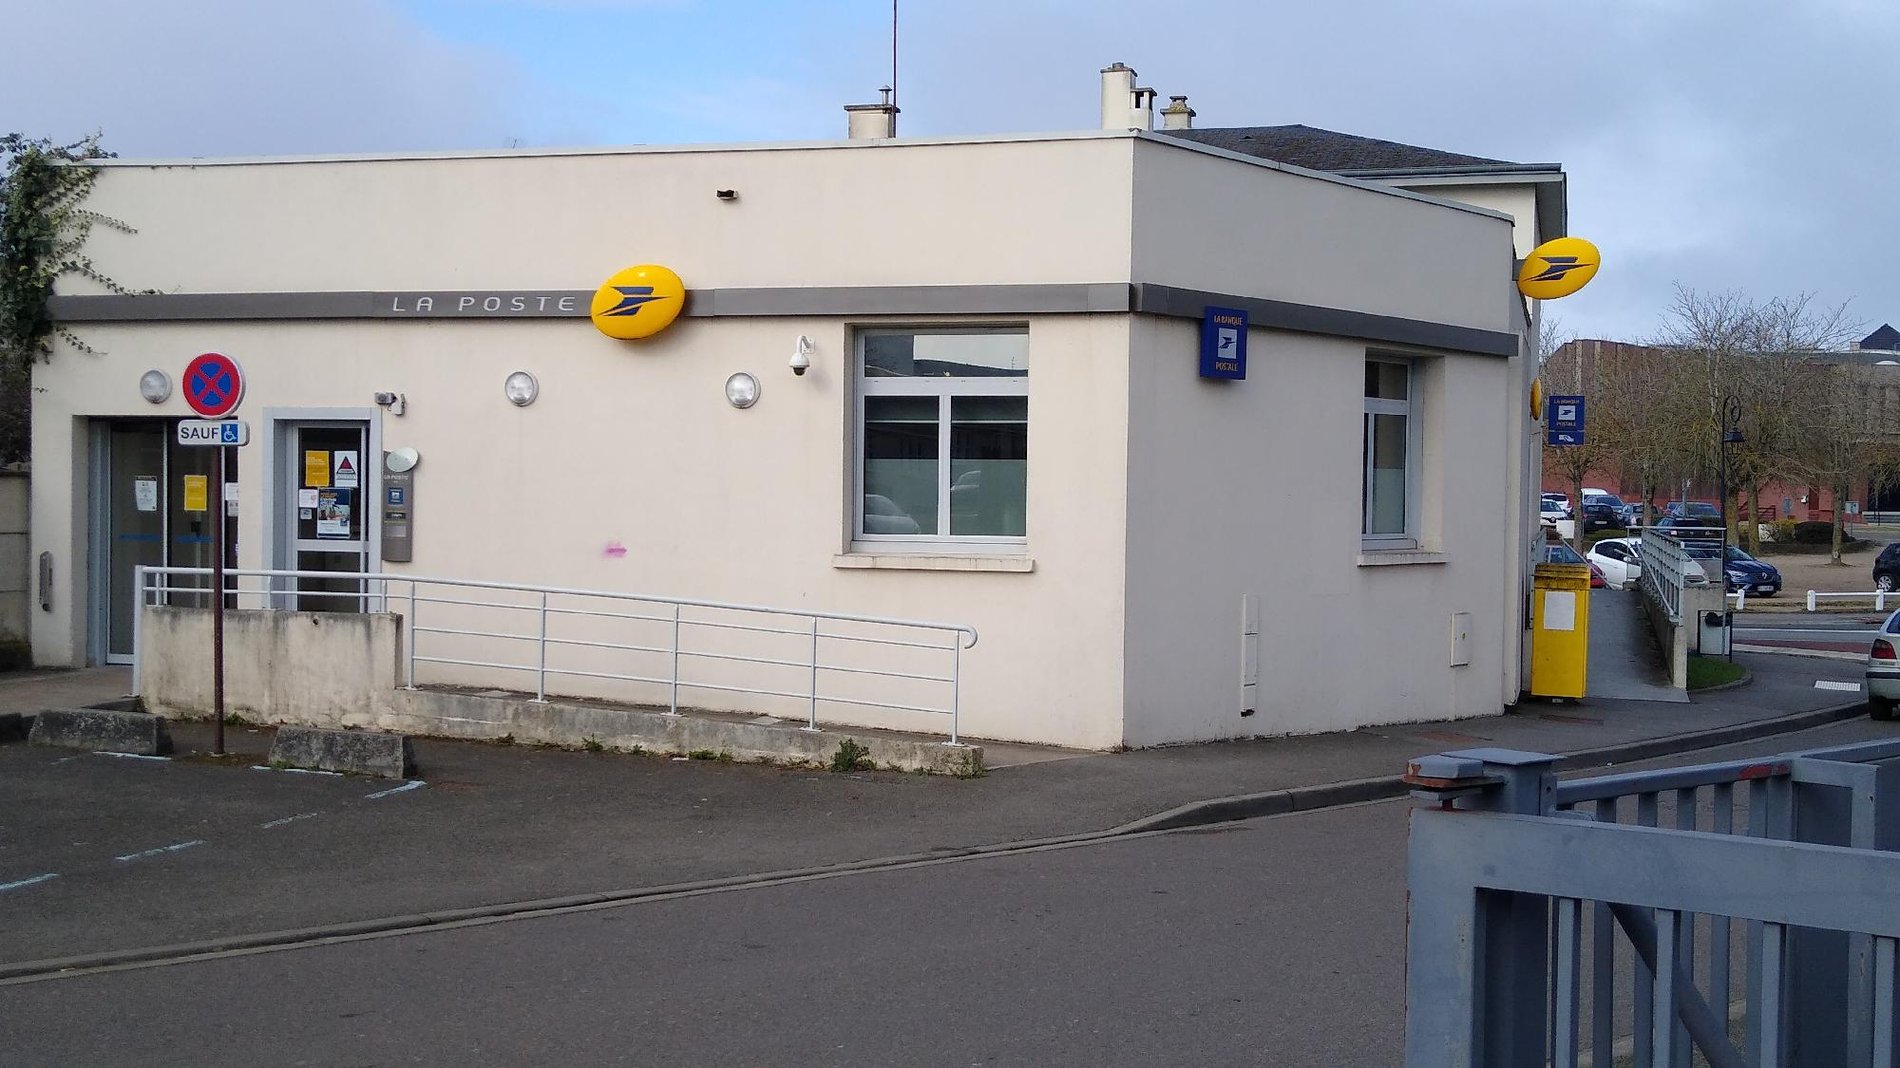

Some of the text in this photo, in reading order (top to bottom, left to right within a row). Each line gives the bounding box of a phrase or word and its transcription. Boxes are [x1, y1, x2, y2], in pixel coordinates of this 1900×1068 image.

[392, 296, 576, 312] LA POSTE
[180, 427, 219, 439] SAUF
